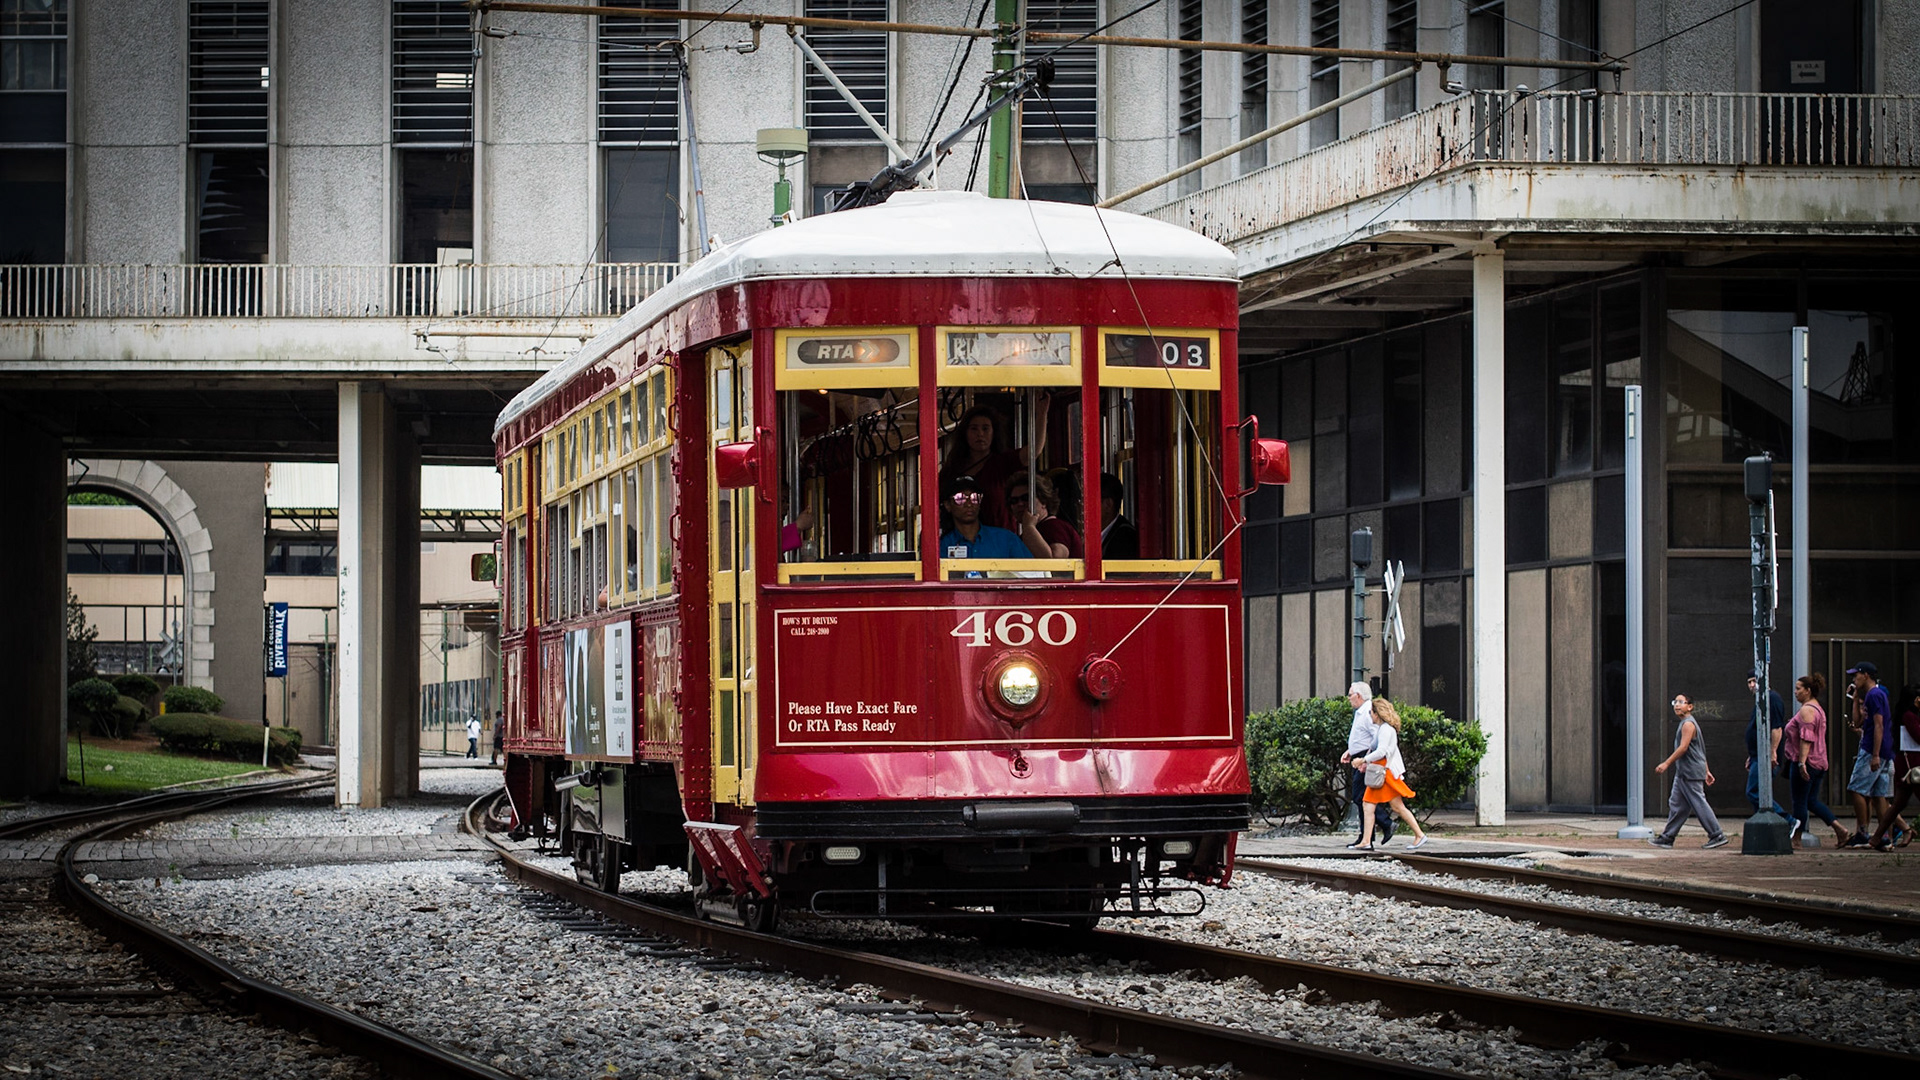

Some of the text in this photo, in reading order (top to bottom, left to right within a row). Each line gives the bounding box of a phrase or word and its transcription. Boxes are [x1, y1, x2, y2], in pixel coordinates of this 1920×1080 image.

[817, 344, 854, 359] RTA
[1162, 341, 1203, 367] 03
[782, 616, 838, 626] HOW'S MY DRIVING
[950, 610, 1077, 647] 460
[275, 609, 287, 668] RIVERWALK
[790, 627, 806, 636] CALL
[788, 701, 918, 715] Please Have Exact Fare
[788, 718, 896, 734] Or RTA Pass Ready
